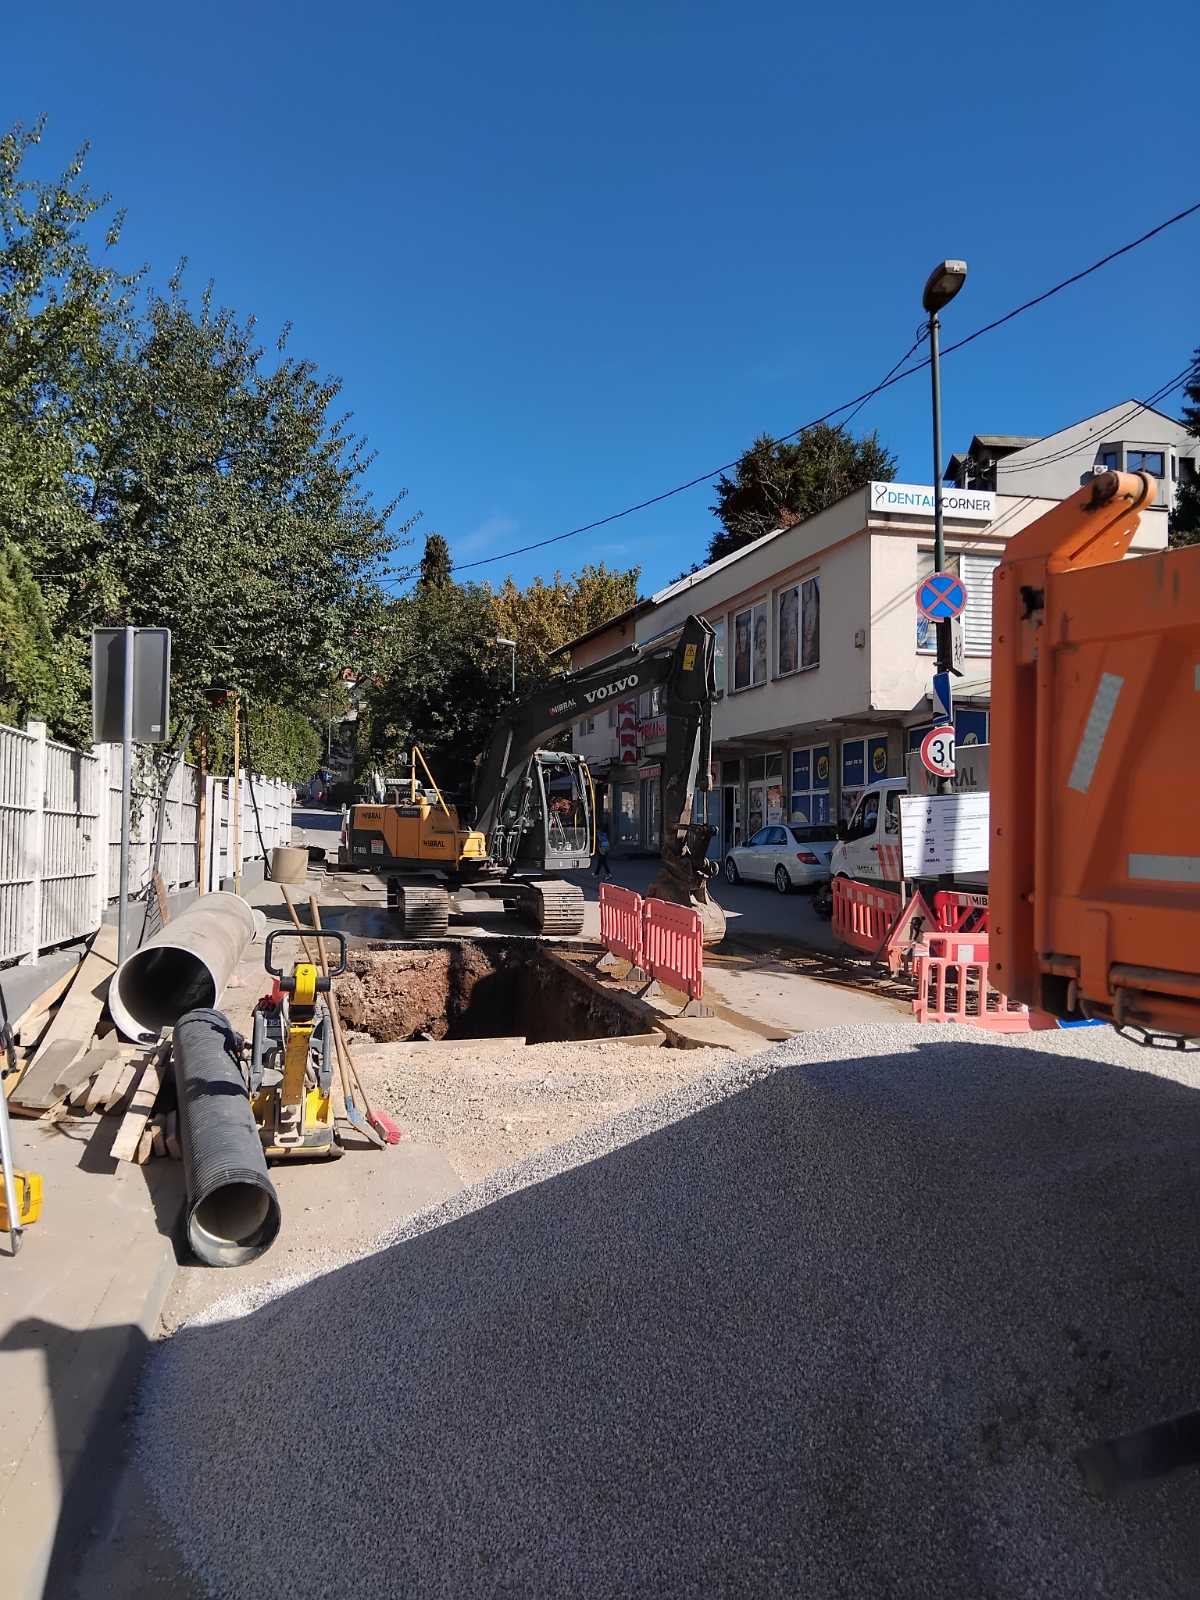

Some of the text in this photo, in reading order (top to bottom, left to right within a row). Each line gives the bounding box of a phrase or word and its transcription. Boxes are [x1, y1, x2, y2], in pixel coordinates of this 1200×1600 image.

[941, 497, 991, 511] CORNER
[584, 674, 639, 703] VOLVO
[926, 767, 977, 788] MRAL
